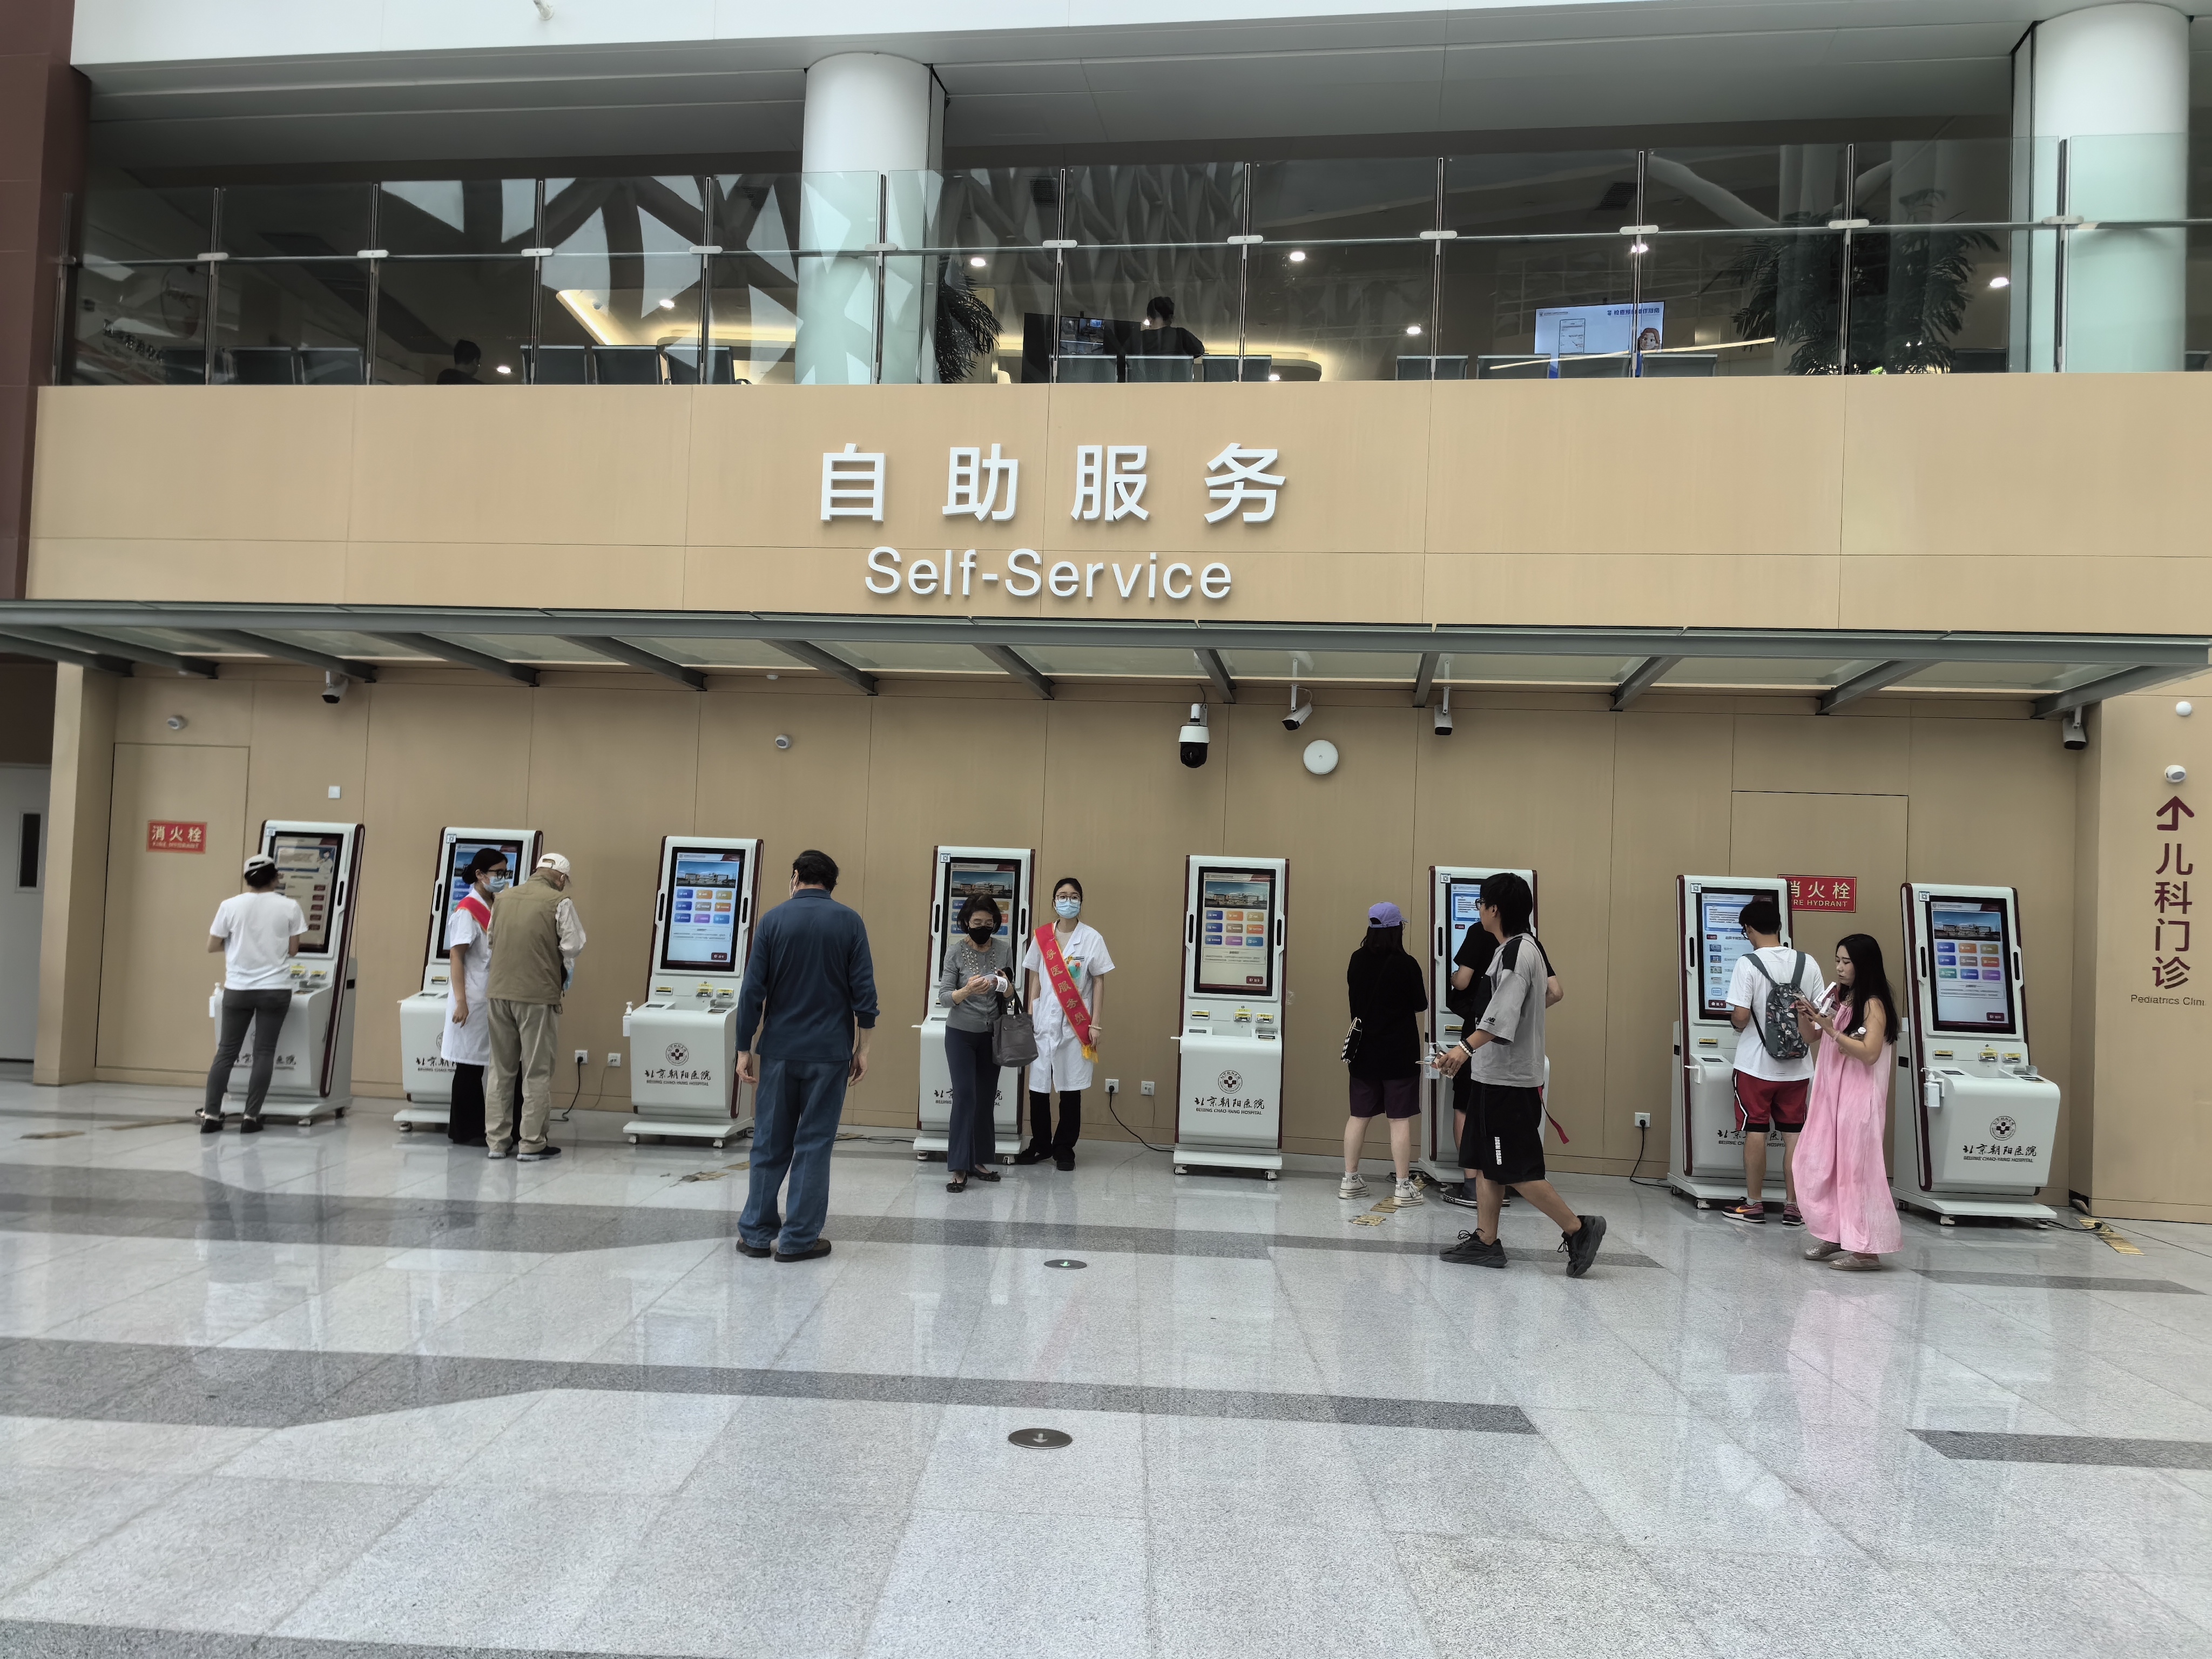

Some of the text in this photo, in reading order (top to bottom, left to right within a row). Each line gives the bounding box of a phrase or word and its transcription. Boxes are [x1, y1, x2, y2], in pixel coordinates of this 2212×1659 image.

[820, 442, 1286, 524] 自助服务
[865, 546, 1232, 599] Self-Service
[152, 825, 203, 843] 消火栓
[2152, 843, 2194, 989] 儿科门诊
[2131, 994, 2179, 1004] Pediatrics
[645, 1069, 711, 1080] 北京朝阳医院
[1195, 1096, 1264, 1109] 北京朝阳医院
[1963, 1144, 2036, 1156] 北京朝阳医院
